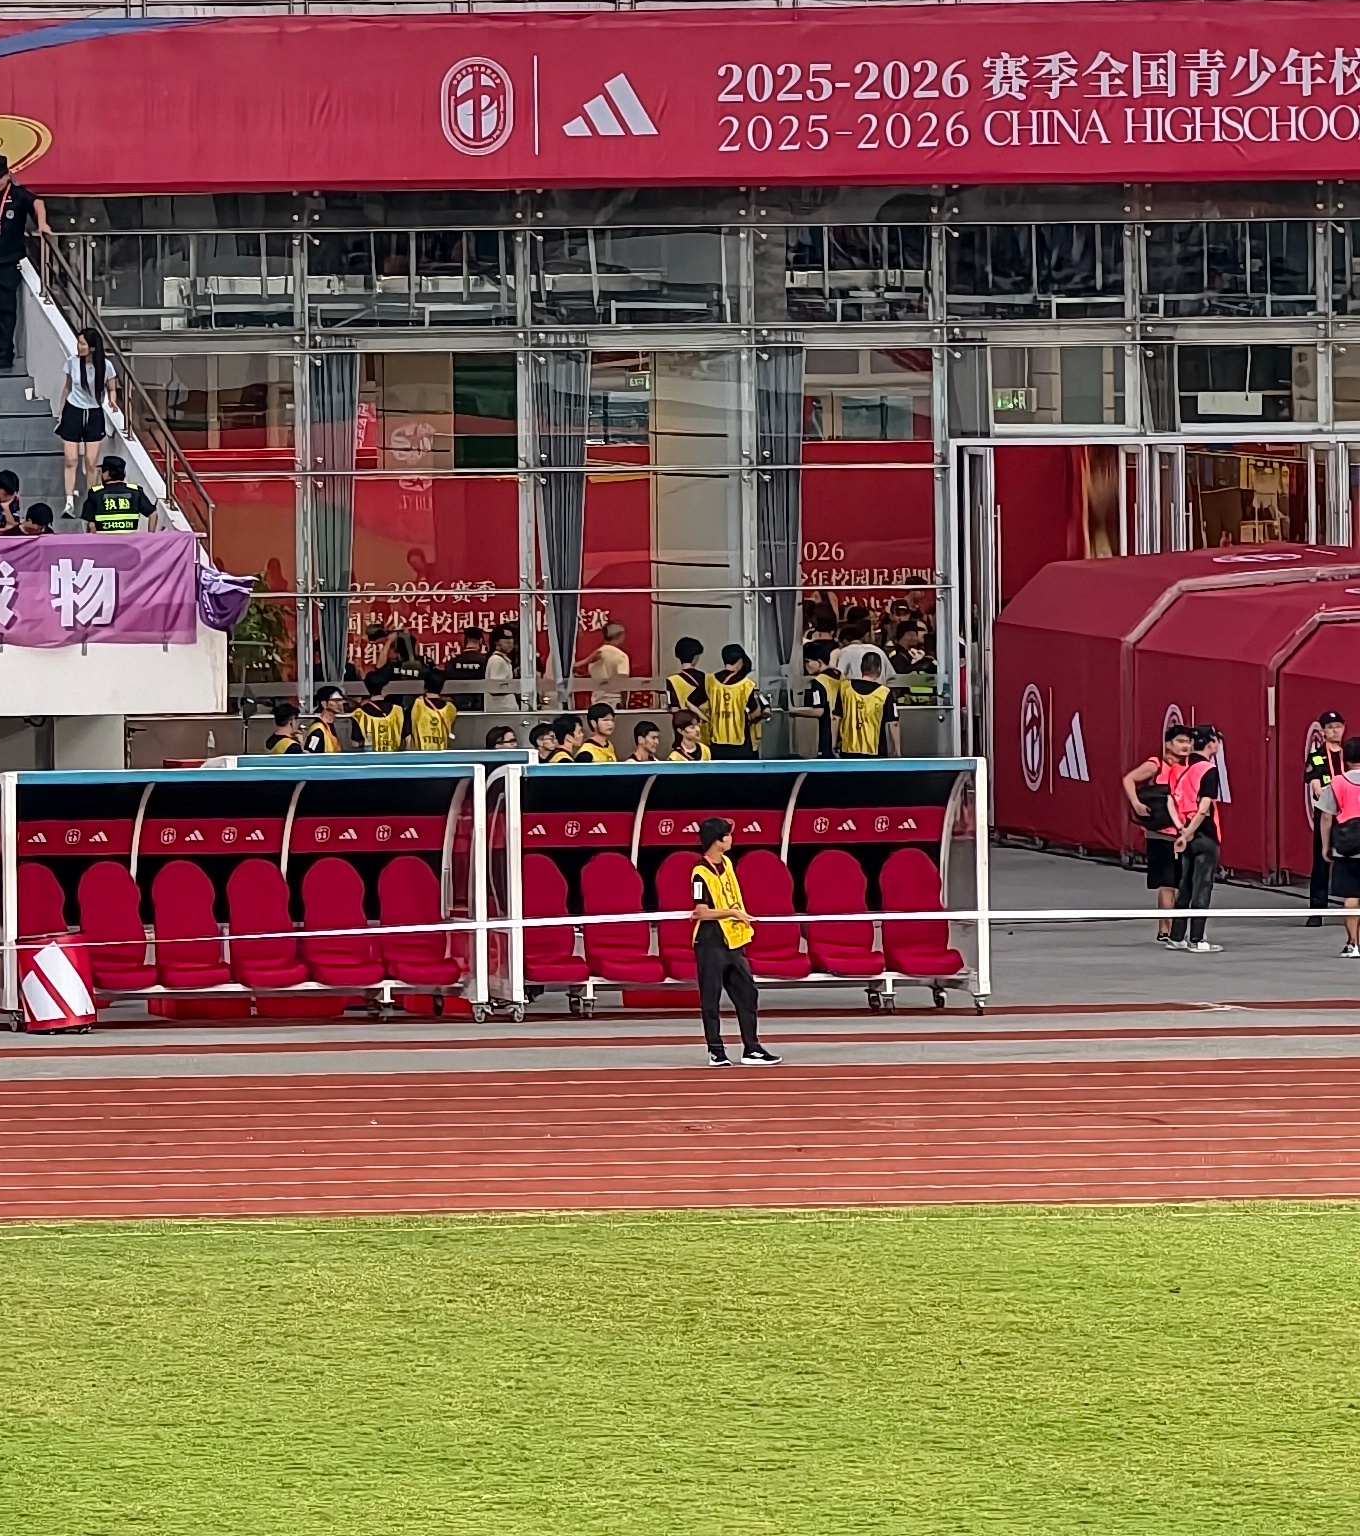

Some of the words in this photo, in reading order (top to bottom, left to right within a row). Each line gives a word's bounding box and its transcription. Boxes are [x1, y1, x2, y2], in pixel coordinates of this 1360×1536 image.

[717, 59, 970, 102] 2025-2026
[982, 47, 1360, 102] 赛季全国青少年校
[717, 110, 970, 152] 2025-2026
[983, 108, 1111, 147] CHINA
[1124, 104, 1360, 144] HIGHSCHOO
